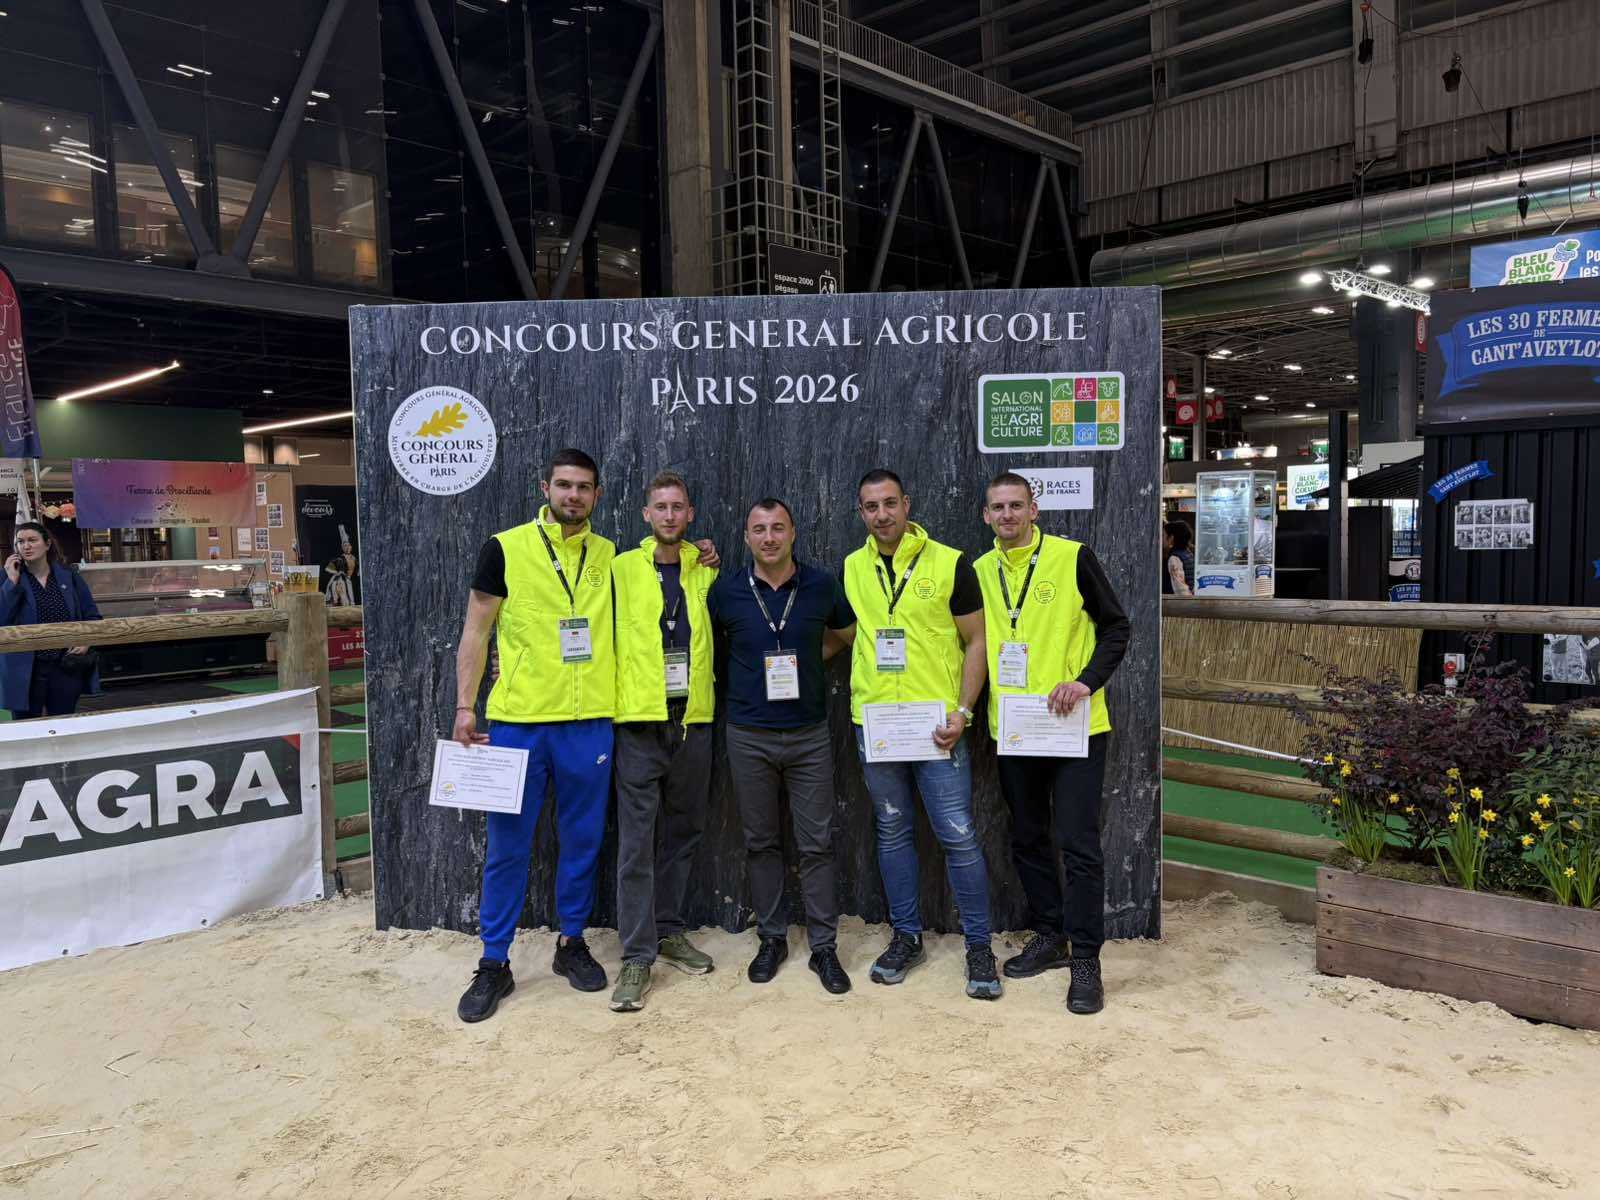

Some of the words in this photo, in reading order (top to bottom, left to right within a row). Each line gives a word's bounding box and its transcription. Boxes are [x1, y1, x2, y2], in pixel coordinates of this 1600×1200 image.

[1513, 252, 1548, 268] BLEU
[1509, 261, 1556, 280] BLANC
[774, 273, 798, 283] espace
[798, 276, 814, 286] 2000
[420, 321, 659, 355] CONCOURS
[672, 316, 862, 351] GENERAL
[875, 311, 1087, 346] AGRICOLE
[1467, 316, 1503, 339] LES
[1508, 312, 1530, 330] 30
[1533, 328, 1546, 338] DE
[651, 364, 758, 414] PARIS
[775, 373, 860, 404] 2026
[991, 391, 1043, 405] SALON
[459, 395, 488, 423] AGRICOLE
[991, 426, 1044, 438] CULTURE
[401, 439, 484, 452] CONCOURS
[408, 450, 477, 465] GÉNÉRAL
[430, 465, 457, 478] PARIS
[1046, 480, 1081, 489] RACES
[0, 750, 290, 852] AGRA
